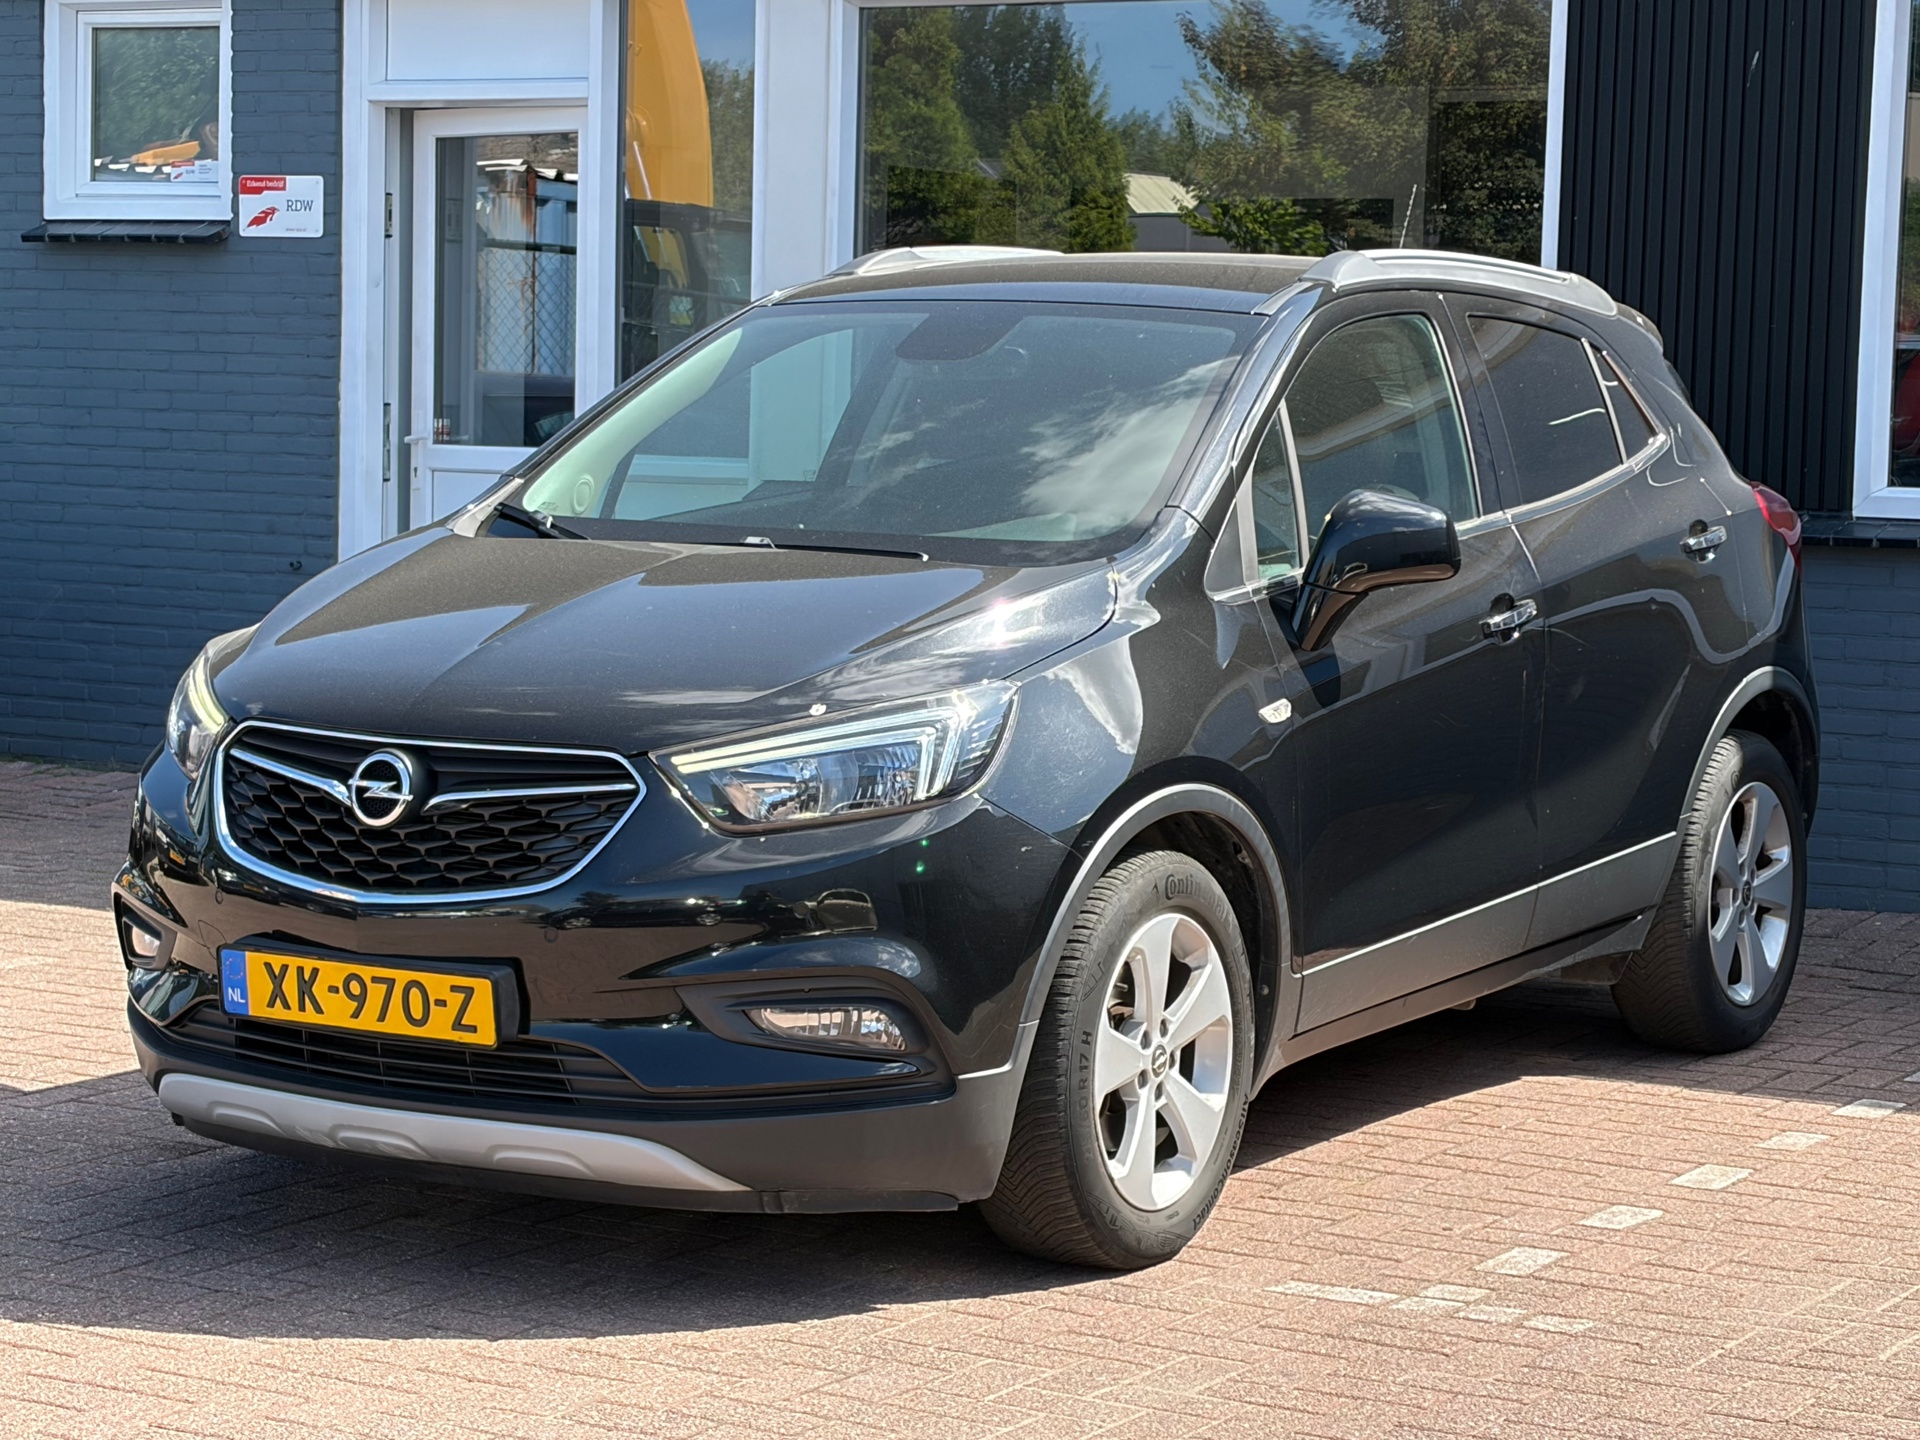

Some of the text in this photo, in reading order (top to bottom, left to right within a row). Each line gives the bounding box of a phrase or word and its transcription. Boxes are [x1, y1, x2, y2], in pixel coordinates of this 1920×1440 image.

[286, 199, 314, 212] RDW
[228, 986, 246, 1004] NL
[263, 961, 478, 1034] XK-970-Z
[1081, 1030, 1093, 1046] H
